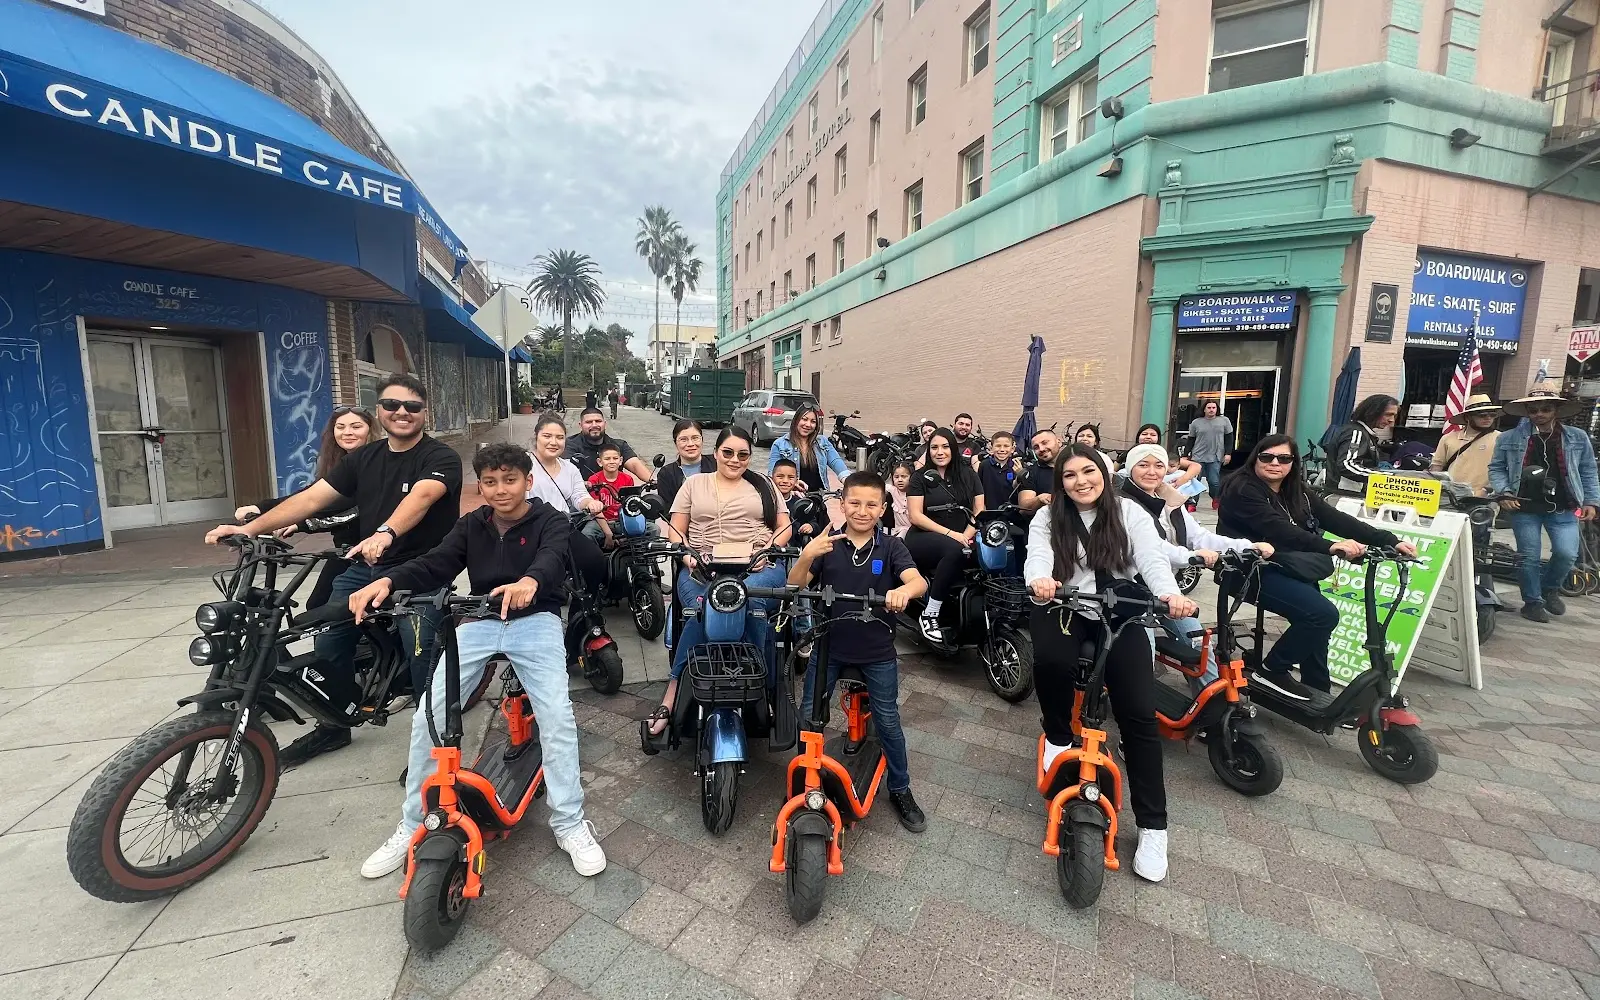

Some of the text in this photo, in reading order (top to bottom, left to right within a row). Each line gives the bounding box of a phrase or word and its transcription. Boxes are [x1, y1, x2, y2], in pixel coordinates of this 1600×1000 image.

[815, 107, 852, 158] HOTEL
[45, 83, 403, 208] CANDLE CAFE
[1426, 260, 1507, 285] BOARDWALK
[123, 280, 200, 299] CANDLE CAFE
[155, 298, 181, 310] 325
[1198, 295, 1276, 307] BOARDWALK
[1409, 292, 1517, 315] BIKE SKATE SURF
[1183, 305, 1290, 317] BIKES SKATE SURF
[1200, 316, 1233, 324] RENTALS
[1424, 321, 1462, 334] RENTALS
[1475, 325, 1495, 336] ALES
[1404, 336, 1518, 351] .boardwalkskate.com 10-450-664
[1570, 330, 1599, 344] ATM
[1570, 342, 1599, 350] HERE
[1386, 476, 1420, 487] iPHONE
[1372, 482, 1435, 495] ACCESSORIES
[1375, 490, 1401, 498] Portable
